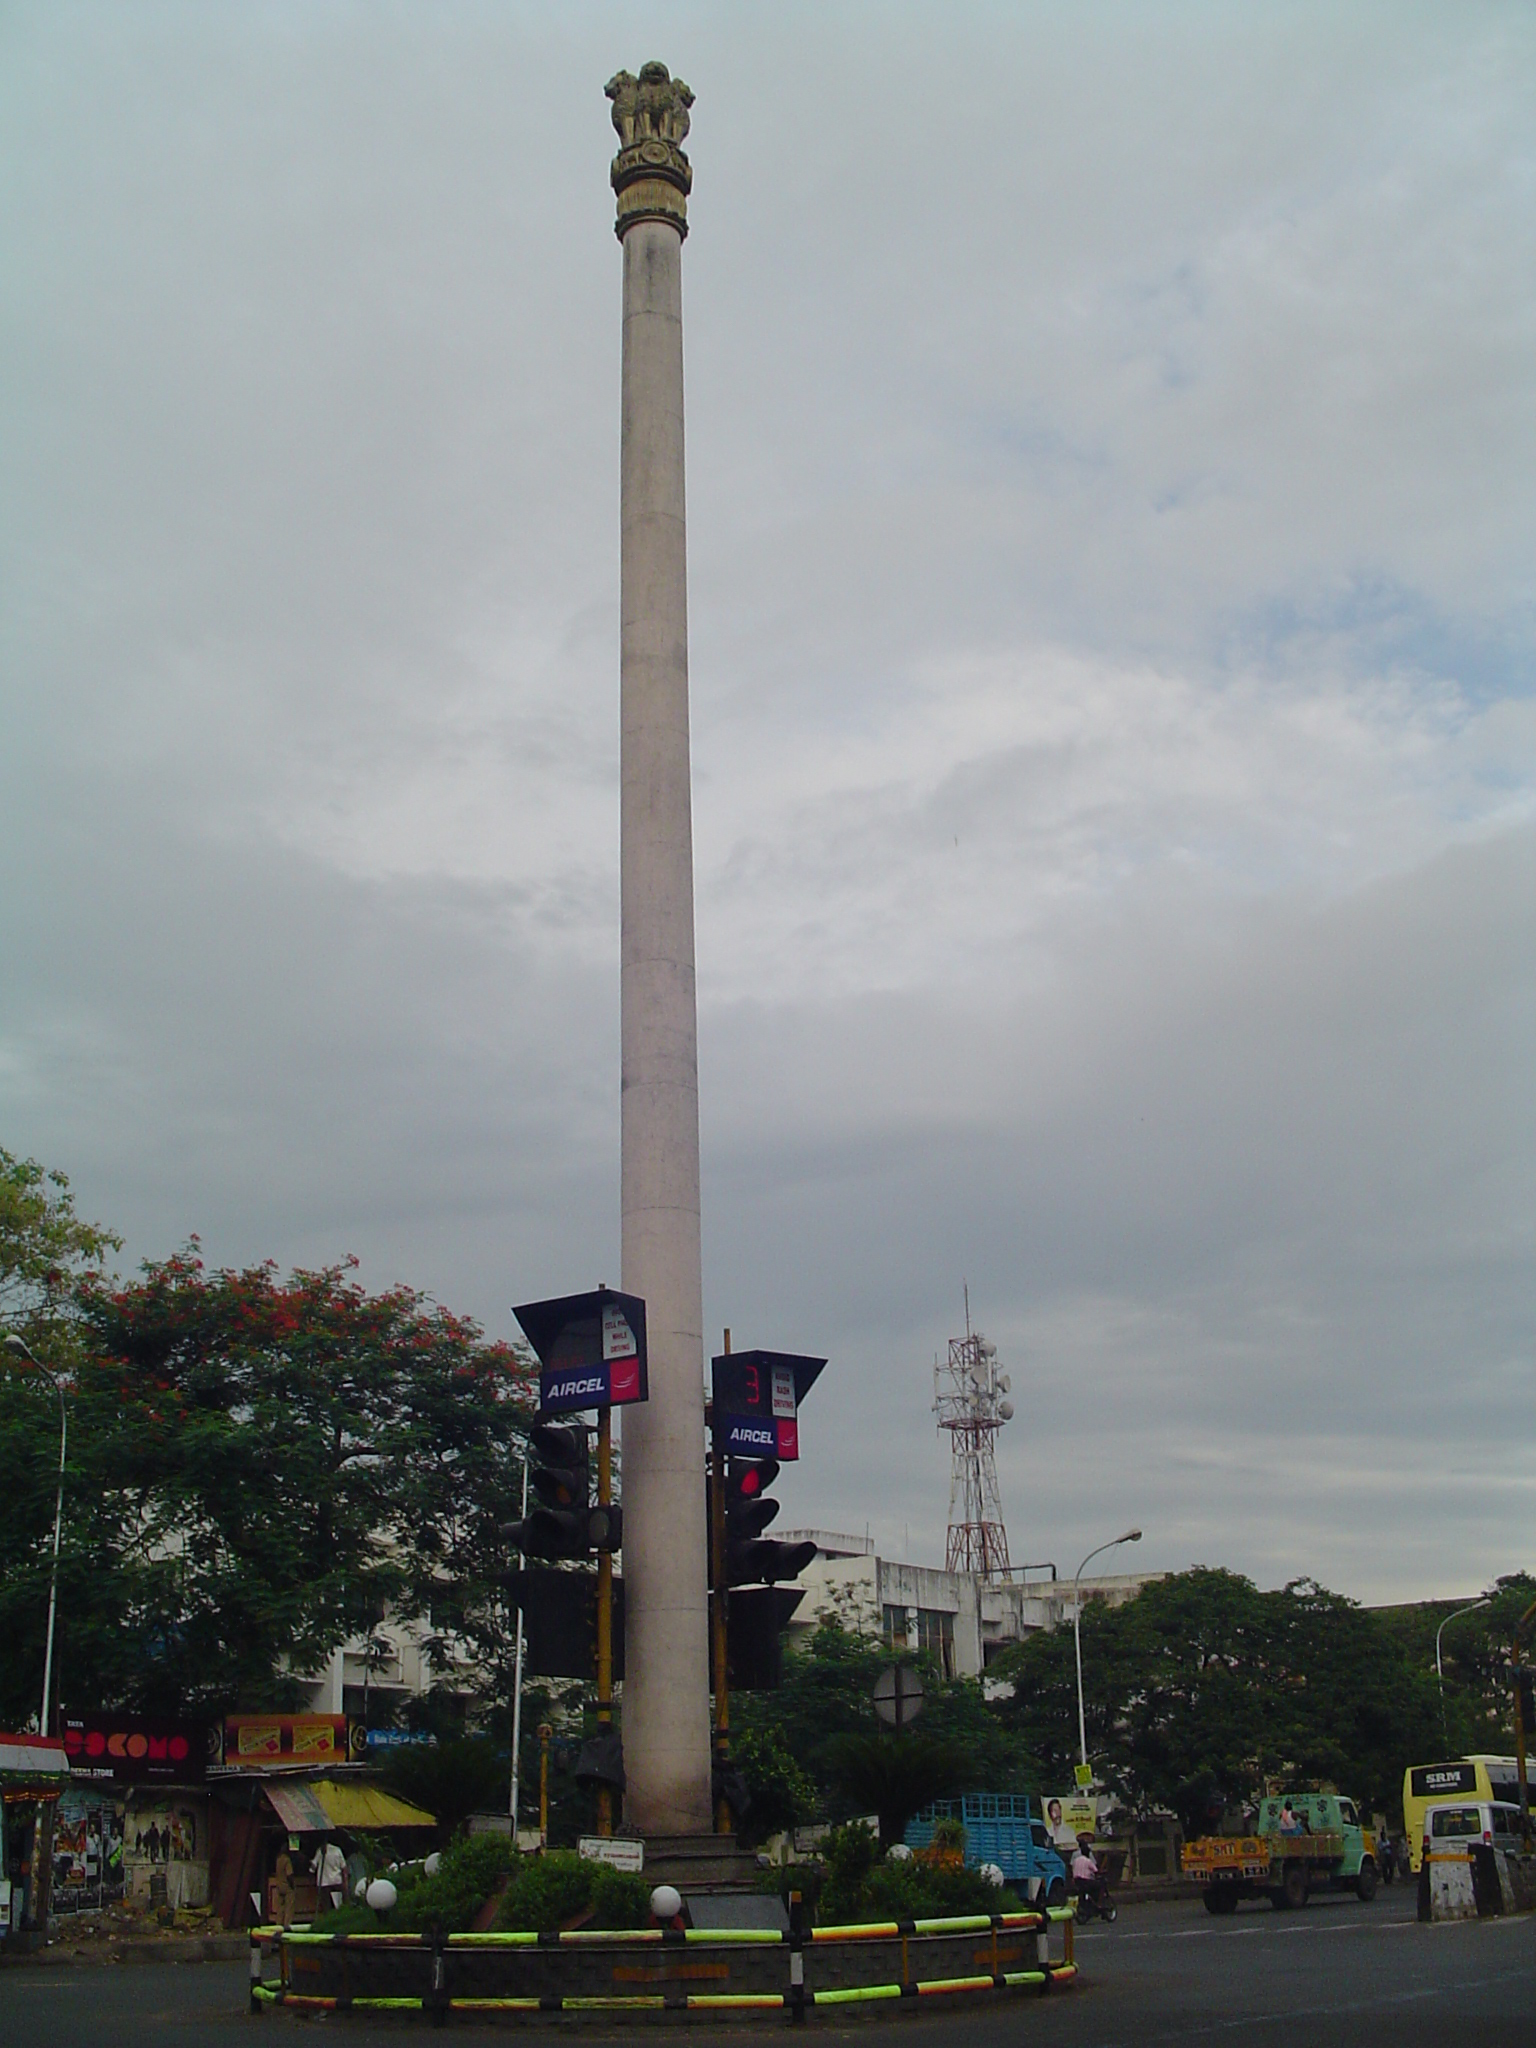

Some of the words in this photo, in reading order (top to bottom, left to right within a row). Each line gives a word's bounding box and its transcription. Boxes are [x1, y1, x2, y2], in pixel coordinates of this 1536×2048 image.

[547, 1378, 605, 1398] AIRCEL
[746, 1365, 759, 1404] 3
[730, 1428, 774, 1445] AIRCEL
[67, 1720, 84, 1728] TATA
[64, 1730, 189, 1760] DOCOMO
[1426, 1771, 1461, 1784] SRM
